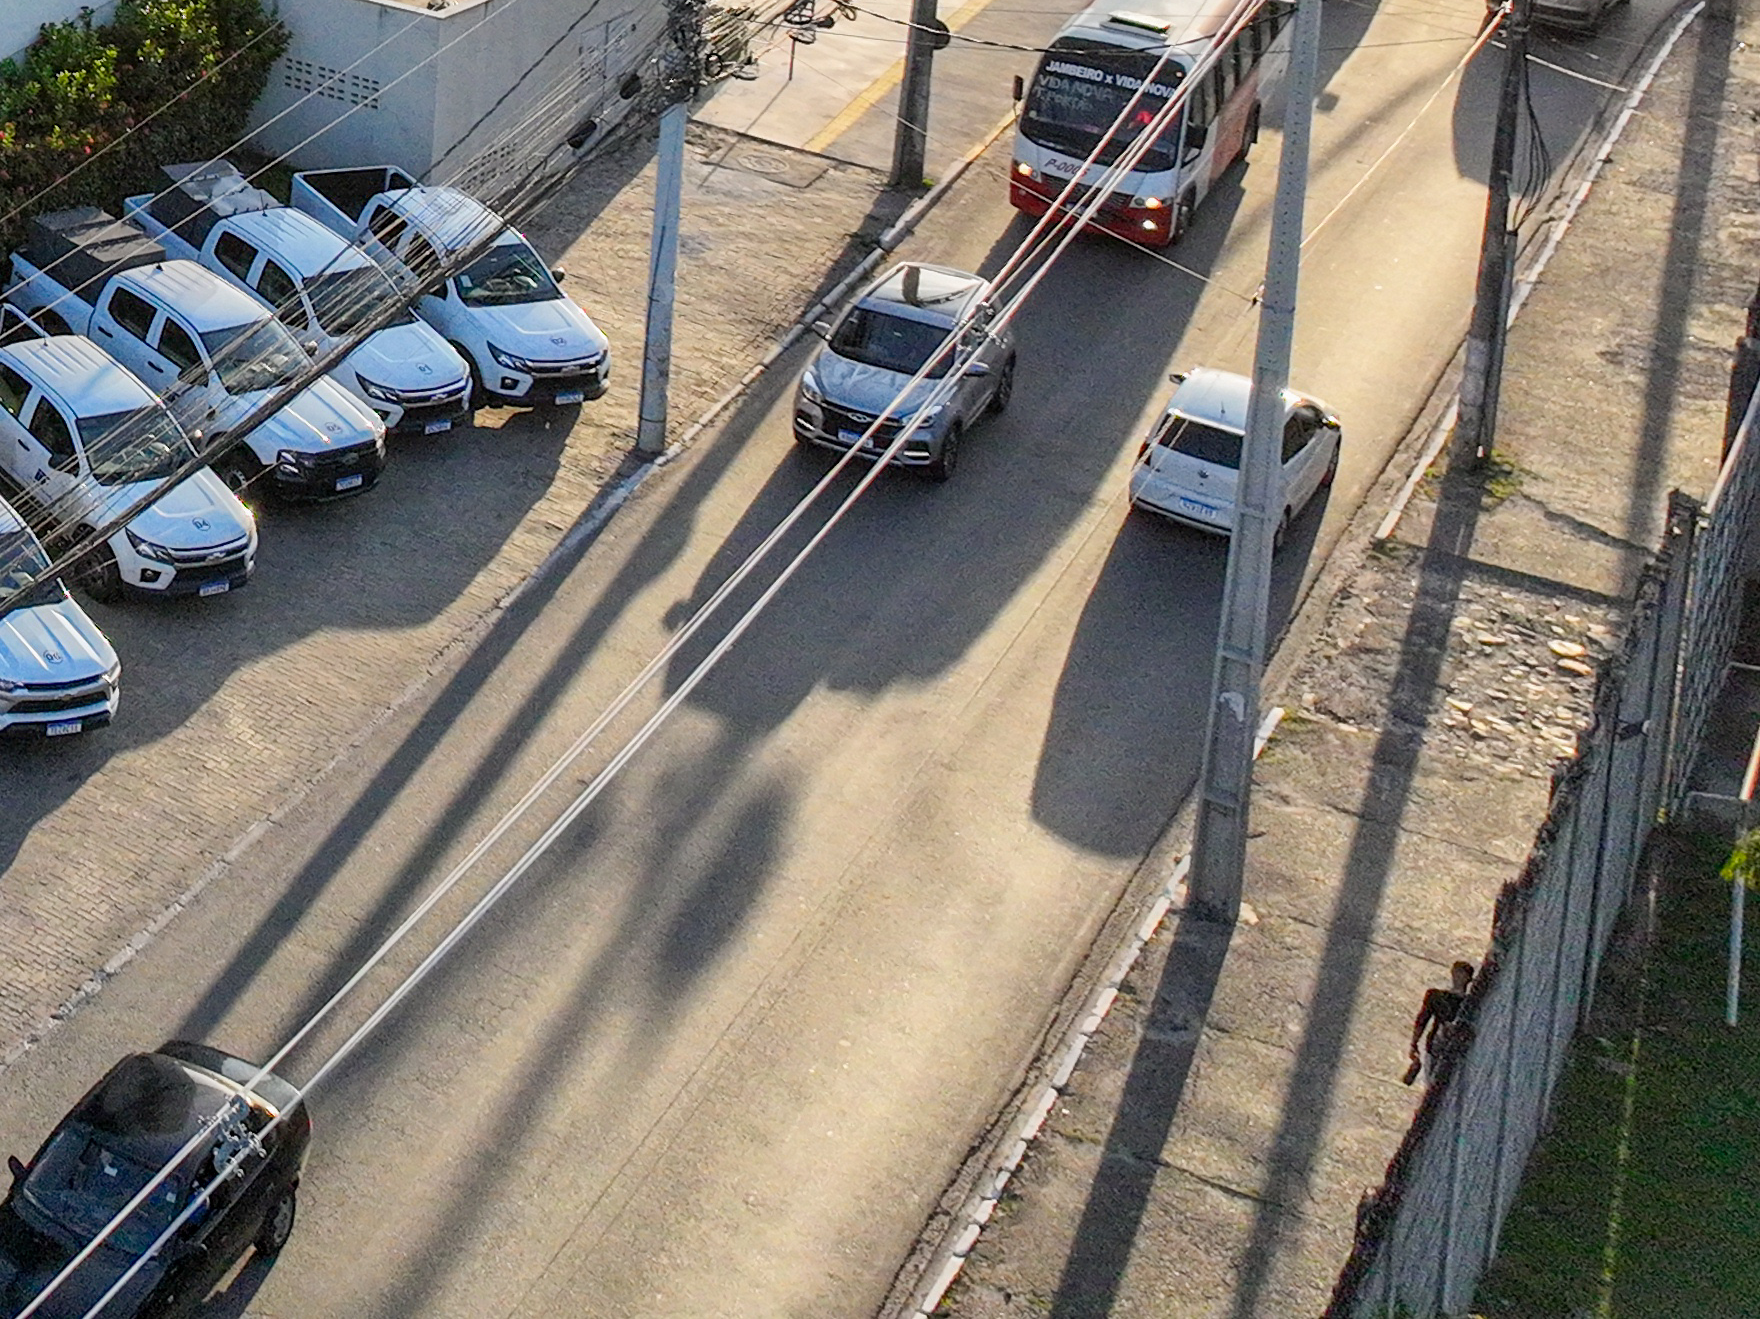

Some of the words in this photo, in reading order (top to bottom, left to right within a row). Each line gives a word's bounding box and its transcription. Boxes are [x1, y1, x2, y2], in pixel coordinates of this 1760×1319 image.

[1039, 74, 1070, 91] VIDA
[1045, 60, 1104, 83] JAMBEIRO
[1115, 74, 1142, 90] VIDA
